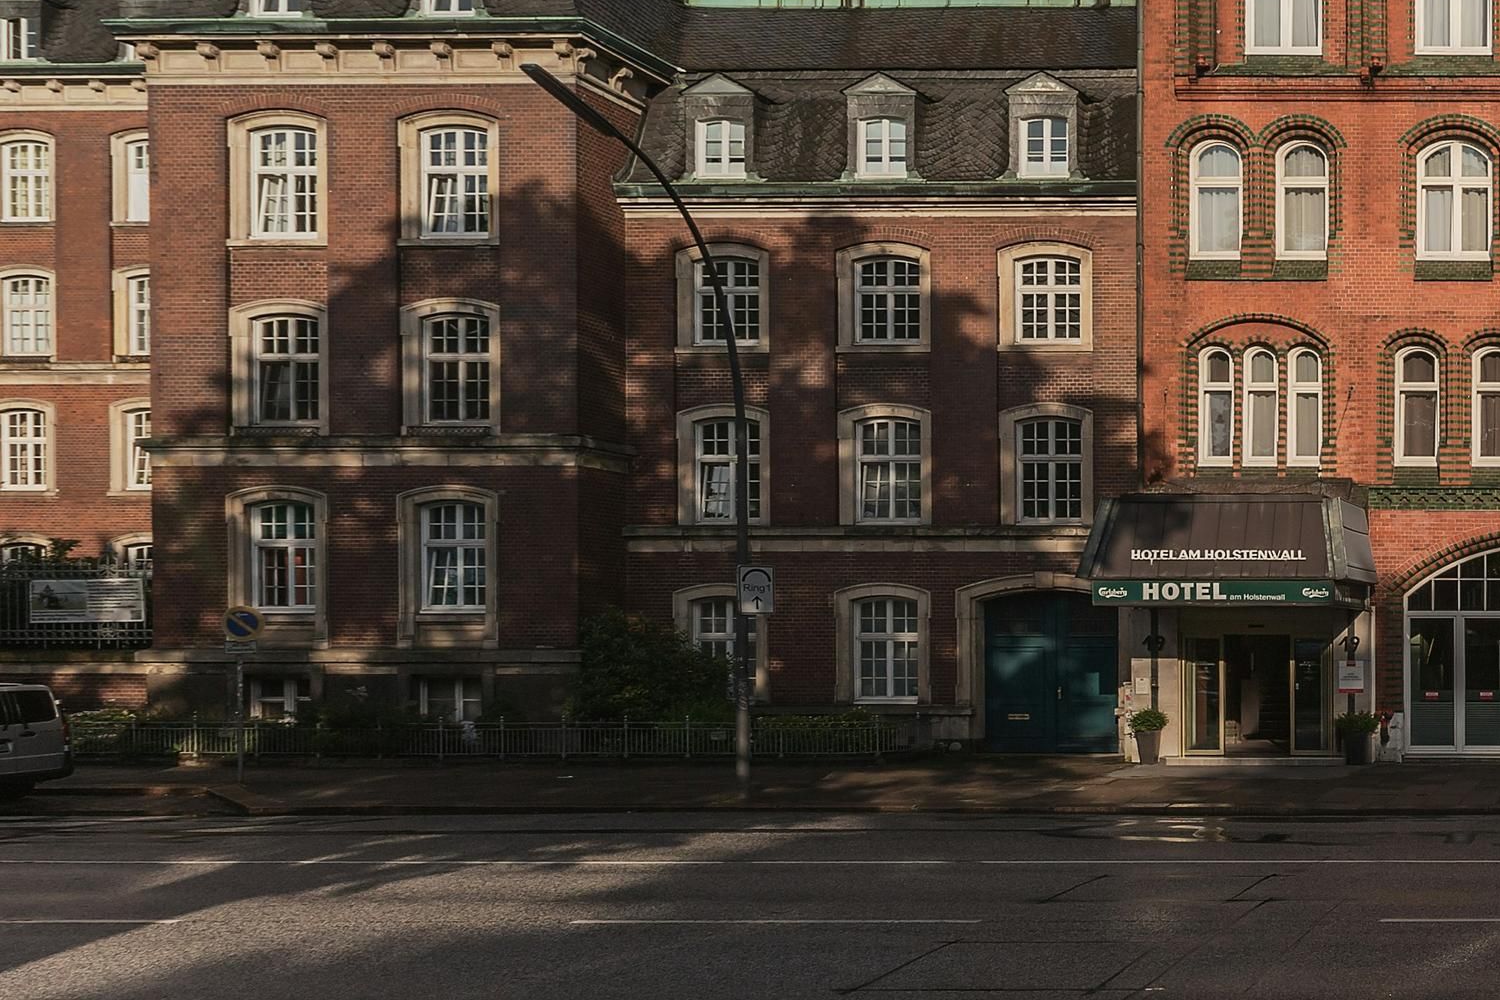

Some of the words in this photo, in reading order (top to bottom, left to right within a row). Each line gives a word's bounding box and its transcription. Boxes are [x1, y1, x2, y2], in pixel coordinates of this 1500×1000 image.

[1131, 549, 1177, 561] HOTEL
[1177, 549, 1201, 561] AM
[1204, 549, 1307, 561] HOLSTENWALL
[743, 584, 765, 593] Ring
[1098, 587, 1128, 599] Carlsberg
[1142, 582, 1227, 601] HOTEL
[1243, 593, 1286, 601] Holstenwall
[1338, 636, 1360, 652] 19
